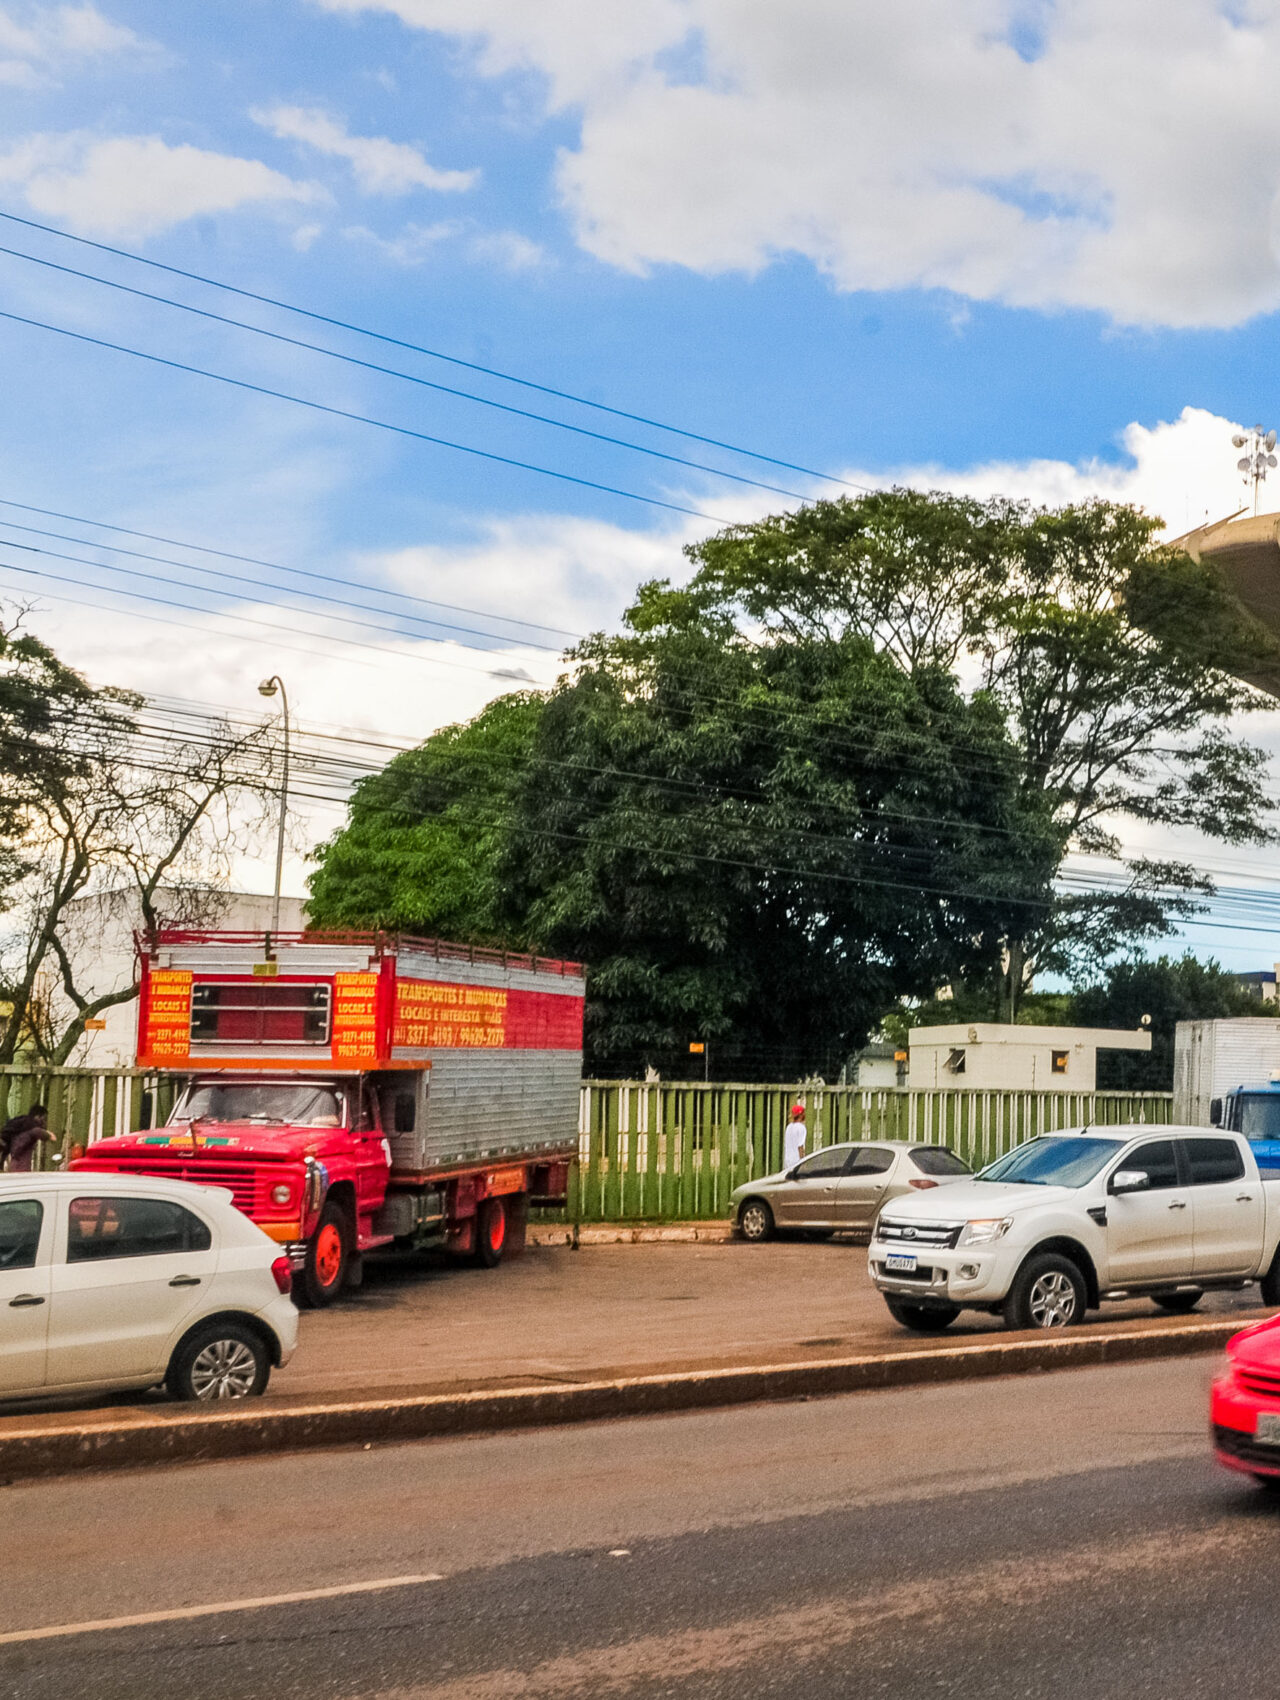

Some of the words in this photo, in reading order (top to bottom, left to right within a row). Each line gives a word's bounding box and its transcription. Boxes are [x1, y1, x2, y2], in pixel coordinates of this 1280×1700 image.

[151, 972, 192, 982] TRANSPORTES
[336, 974, 377, 985] TRANSPORTES
[397, 983, 457, 1004] TRANSPORTES
[459, 988, 464, 1004] E
[465, 990, 507, 1010] MUDANÇAS
[153, 1001, 180, 1011] LOCAIS
[182, 1001, 187, 1011] E
[338, 1003, 366, 1014] LOCAIS
[367, 1003, 372, 1014] E
[400, 1006, 432, 1020] LOCAIS
[434, 1008, 439, 1021] E
[407, 1025, 453, 1045] 3371-4193
